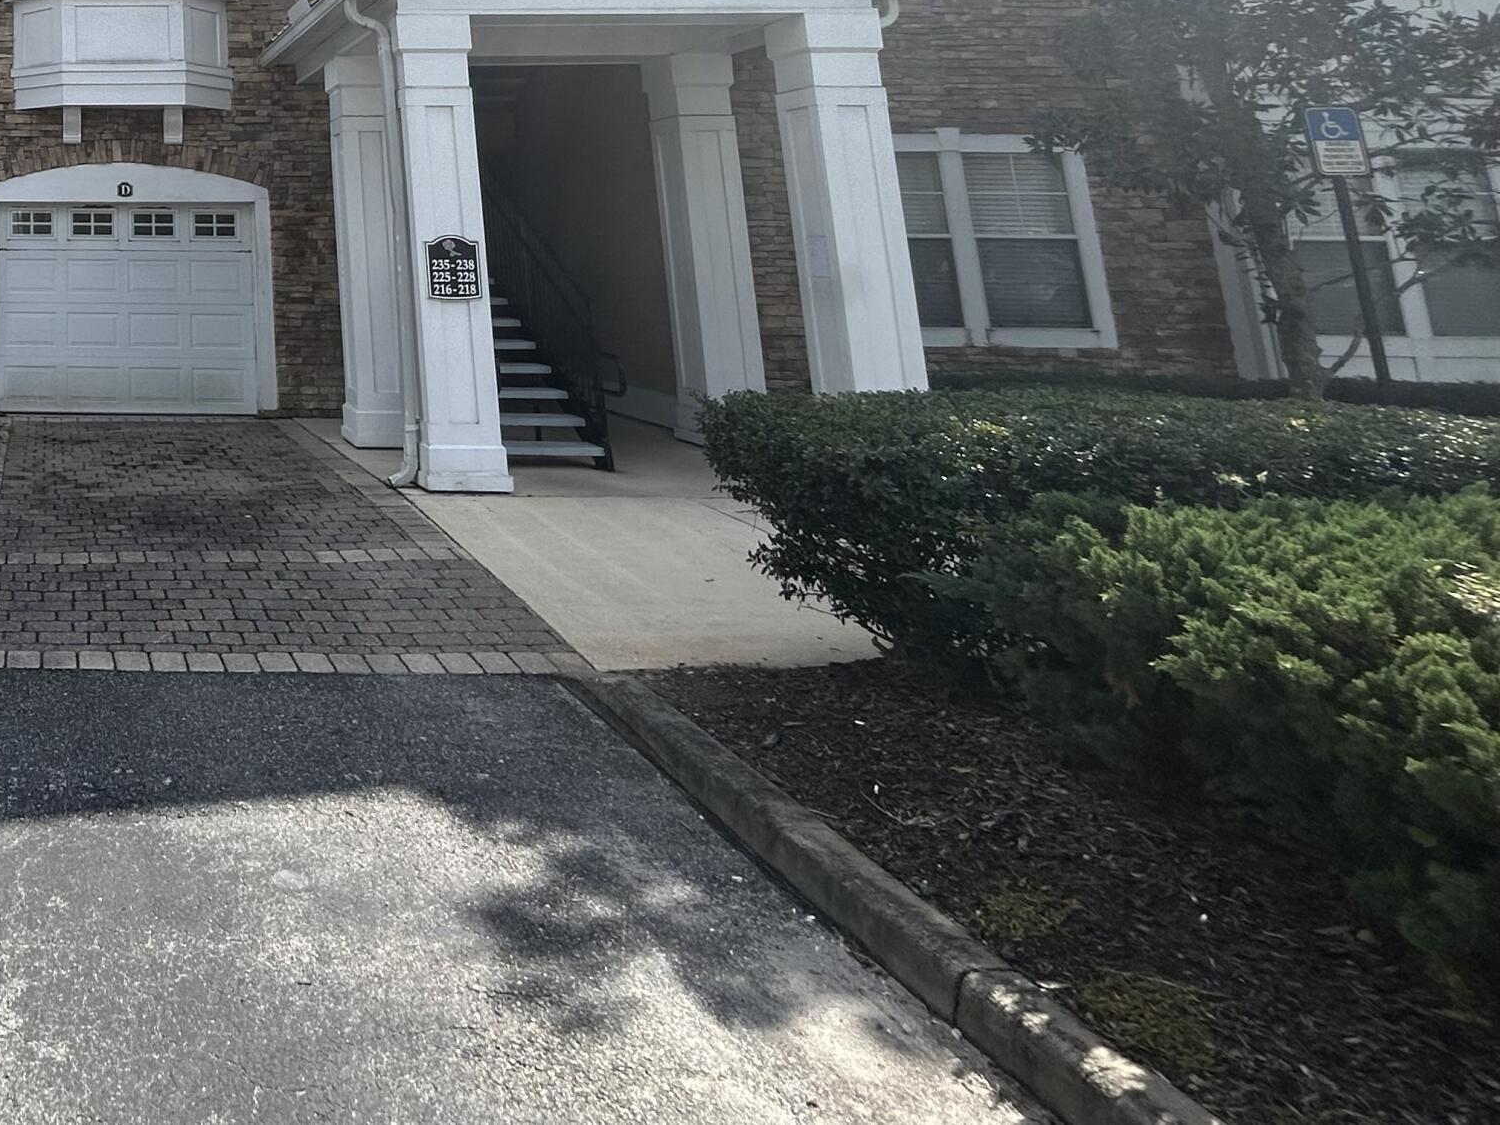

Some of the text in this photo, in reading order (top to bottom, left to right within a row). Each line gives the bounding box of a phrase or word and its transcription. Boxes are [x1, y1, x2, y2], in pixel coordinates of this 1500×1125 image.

[121, 185, 131, 195] D
[431, 259, 475, 270] 235-238
[432, 271, 476, 283] 225-228
[433, 283, 477, 295] 216-218
